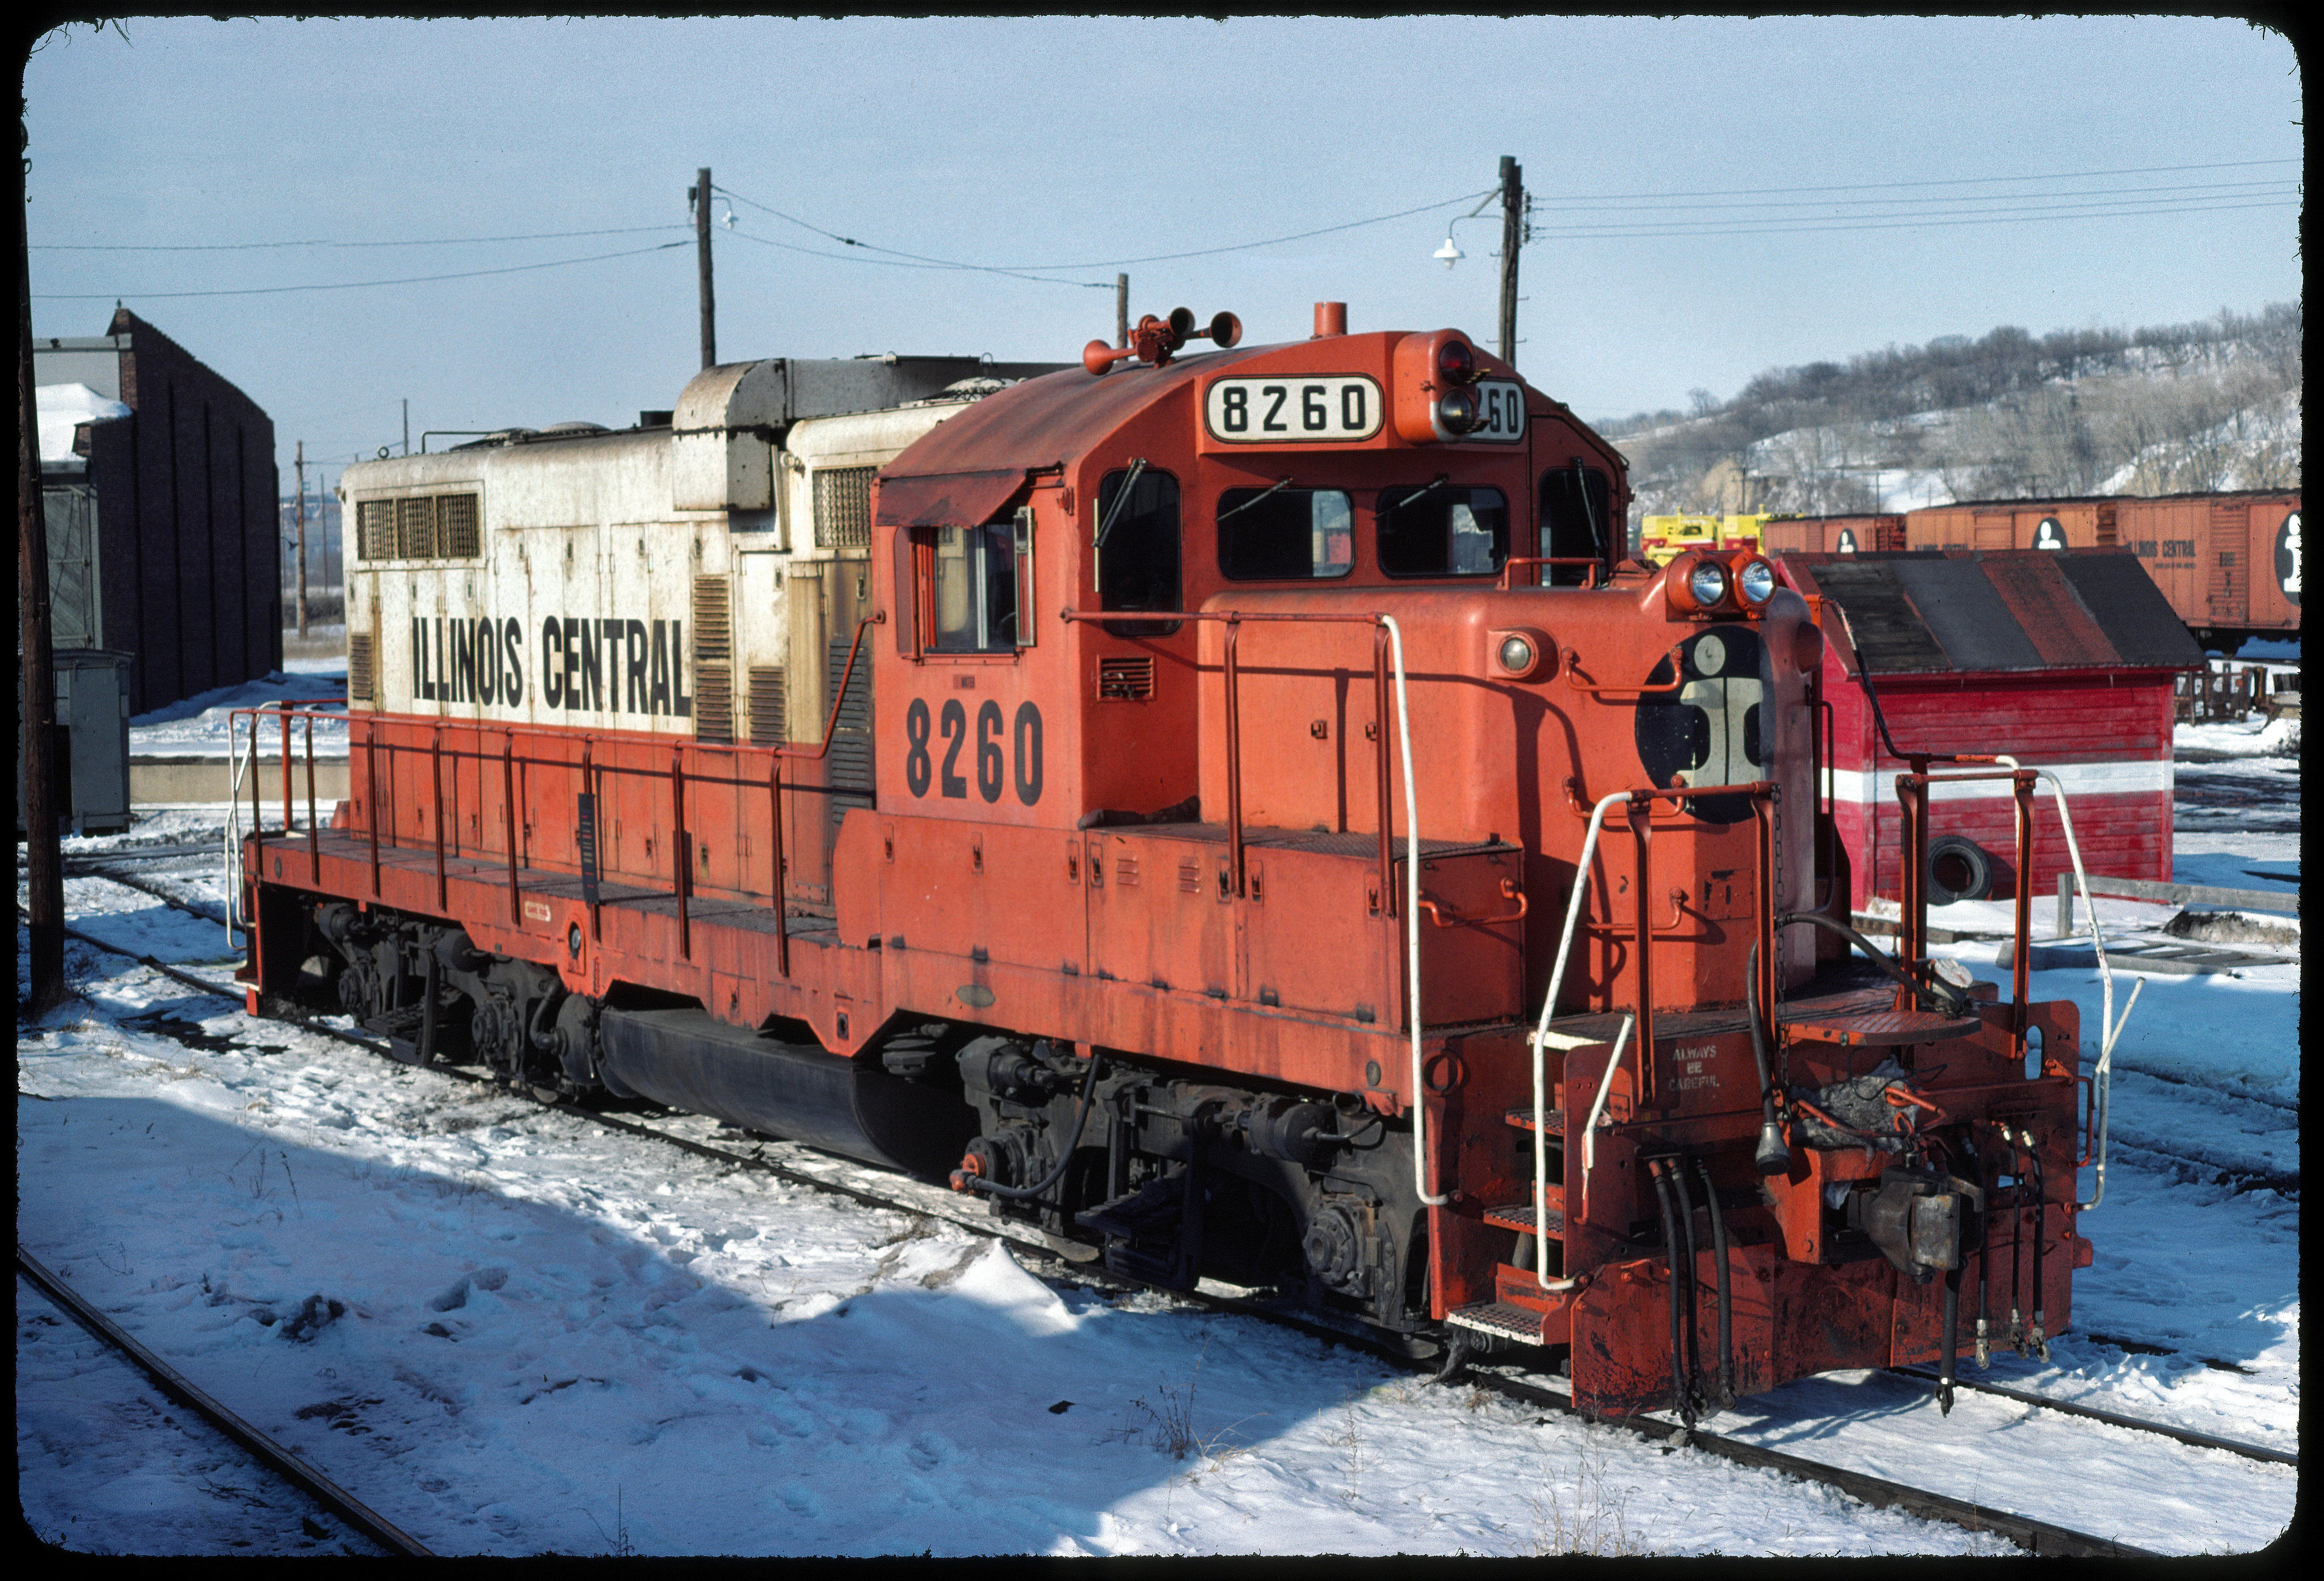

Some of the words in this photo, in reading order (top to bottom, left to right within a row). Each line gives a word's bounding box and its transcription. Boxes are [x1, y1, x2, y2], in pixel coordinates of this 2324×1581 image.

[1223, 385, 1366, 432] 8260
[1477, 388, 1518, 434] 60
[412, 616, 523, 708] ILLINOIS
[542, 615, 692, 717] CENTRAL
[906, 697, 1043, 806] 8260
[1673, 1045, 1717, 1061] ALWAYS
[1687, 1061, 1702, 1074] BE
